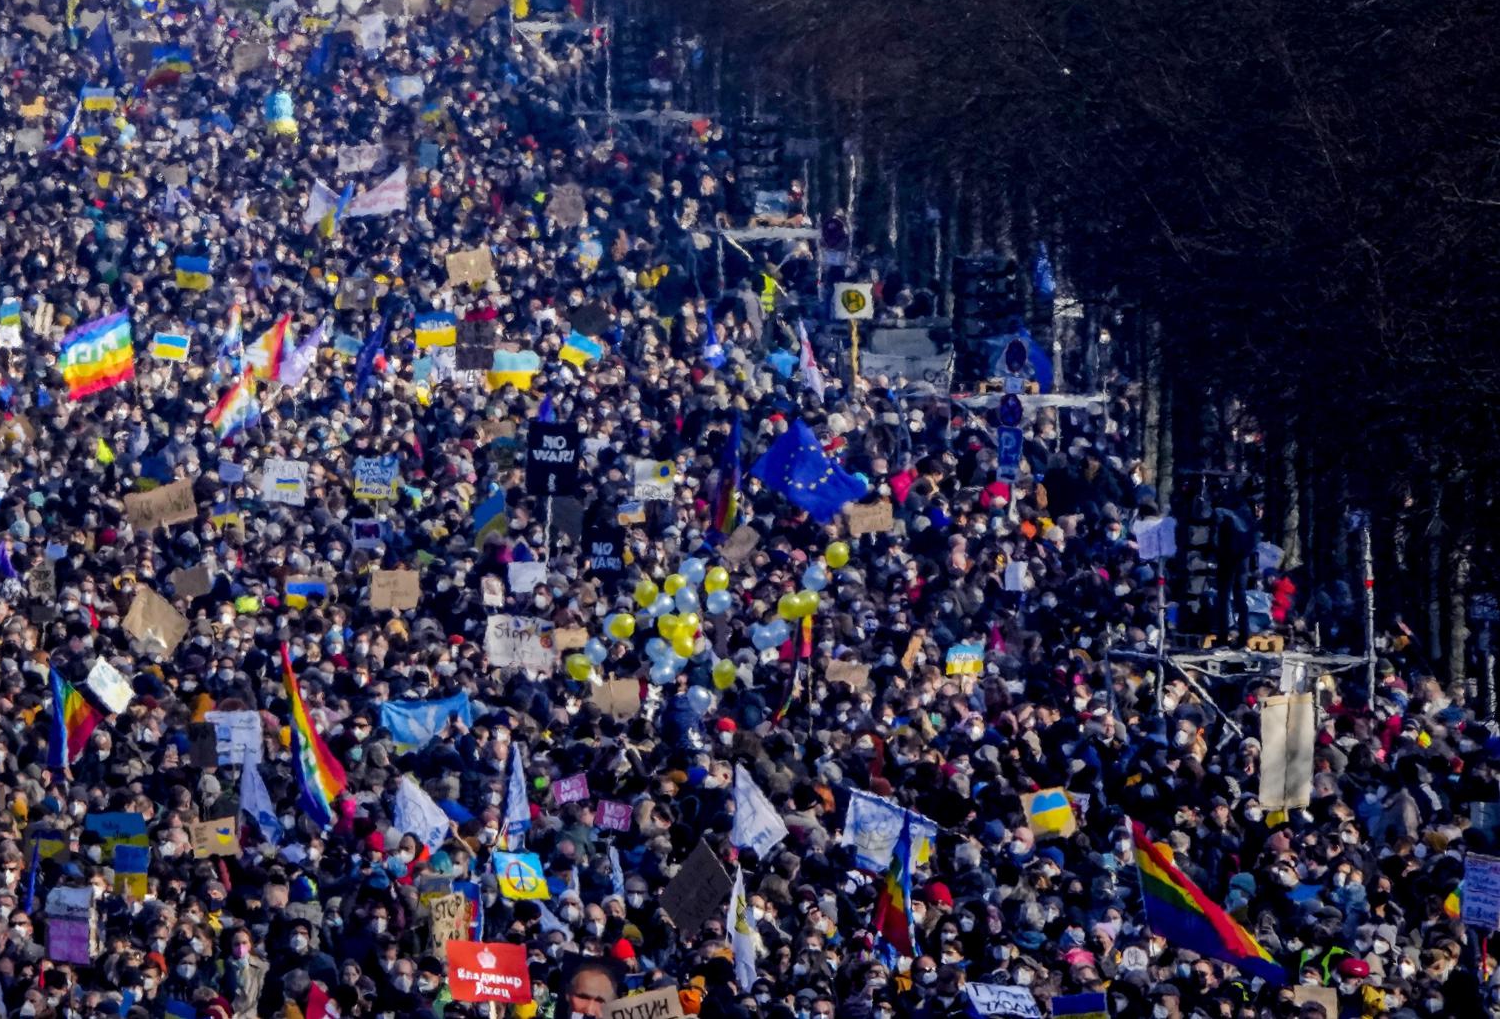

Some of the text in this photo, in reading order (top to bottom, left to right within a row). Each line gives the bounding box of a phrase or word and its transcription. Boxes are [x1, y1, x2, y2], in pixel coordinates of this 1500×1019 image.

[542, 435, 567, 449] NO
[532, 449, 575, 463] WAR!
[591, 542, 613, 555] NO
[435, 895, 463, 921] STOP
[457, 968, 522, 988] Владимир
[611, 999, 670, 1019] ПУТИН
